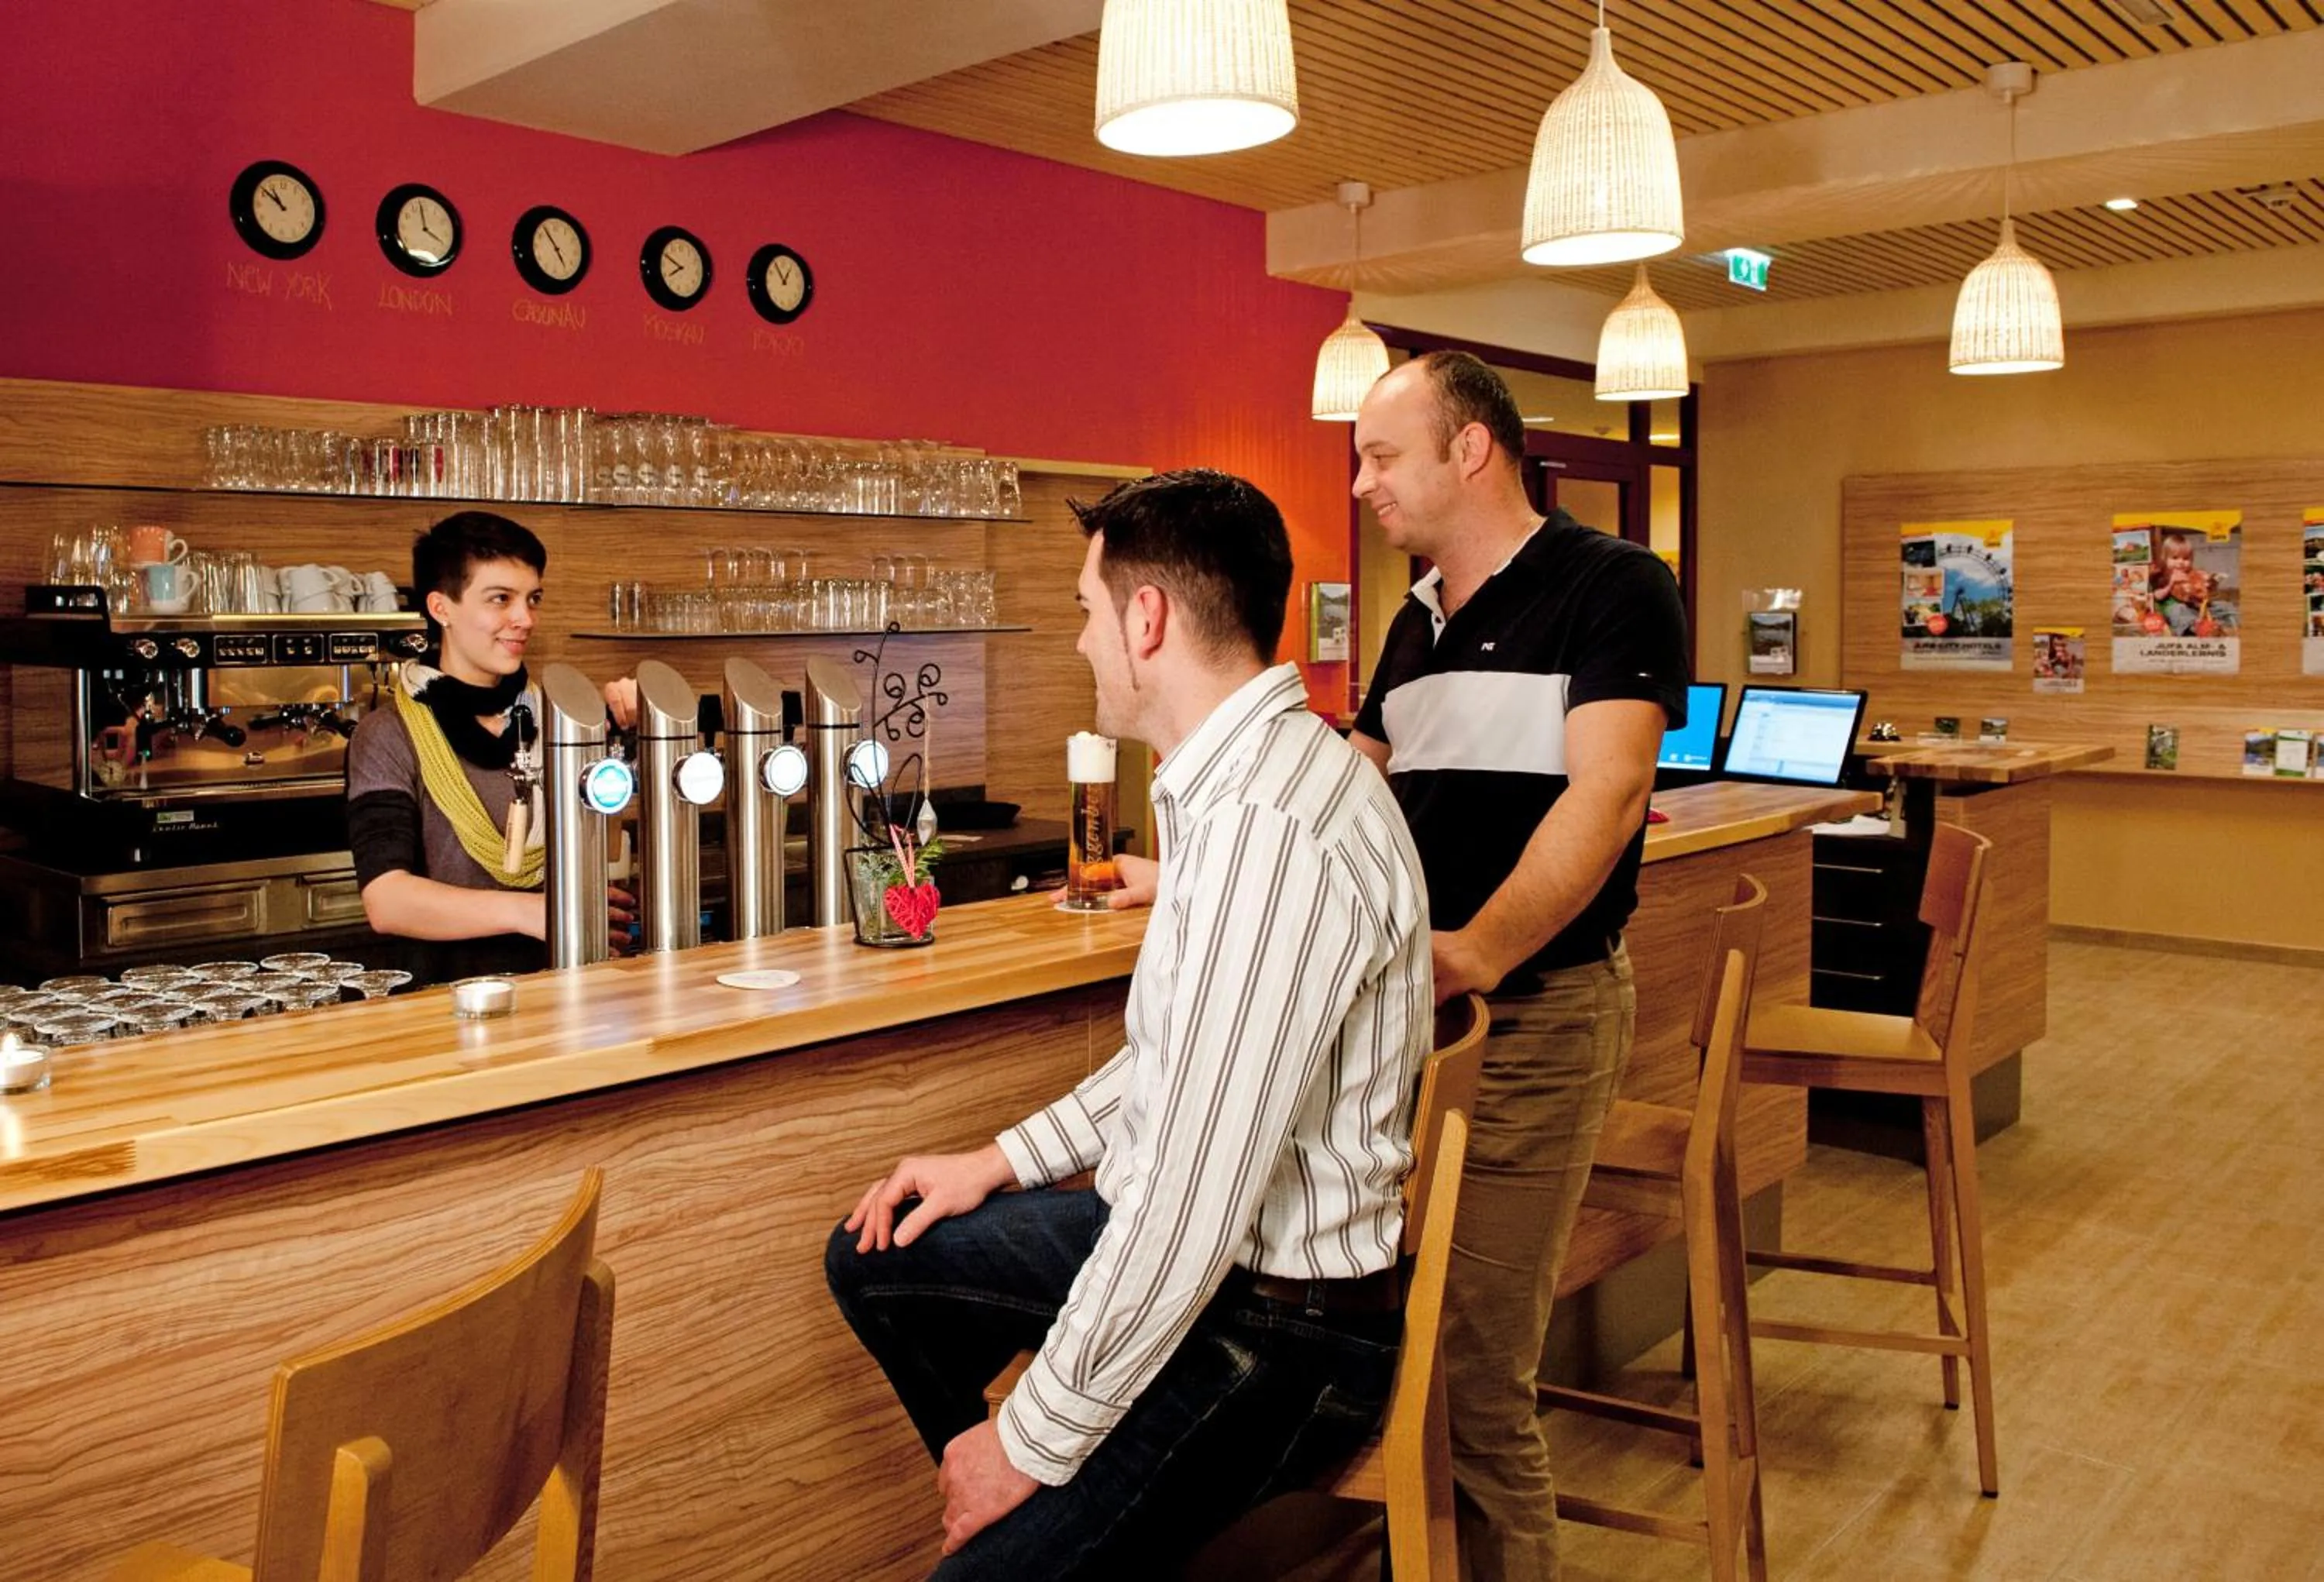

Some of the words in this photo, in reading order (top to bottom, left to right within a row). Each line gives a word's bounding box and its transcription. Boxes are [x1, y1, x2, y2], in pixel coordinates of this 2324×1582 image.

[226, 260, 273, 297] NEW
[283, 270, 334, 312] YORK
[378, 281, 453, 316] LONDON
